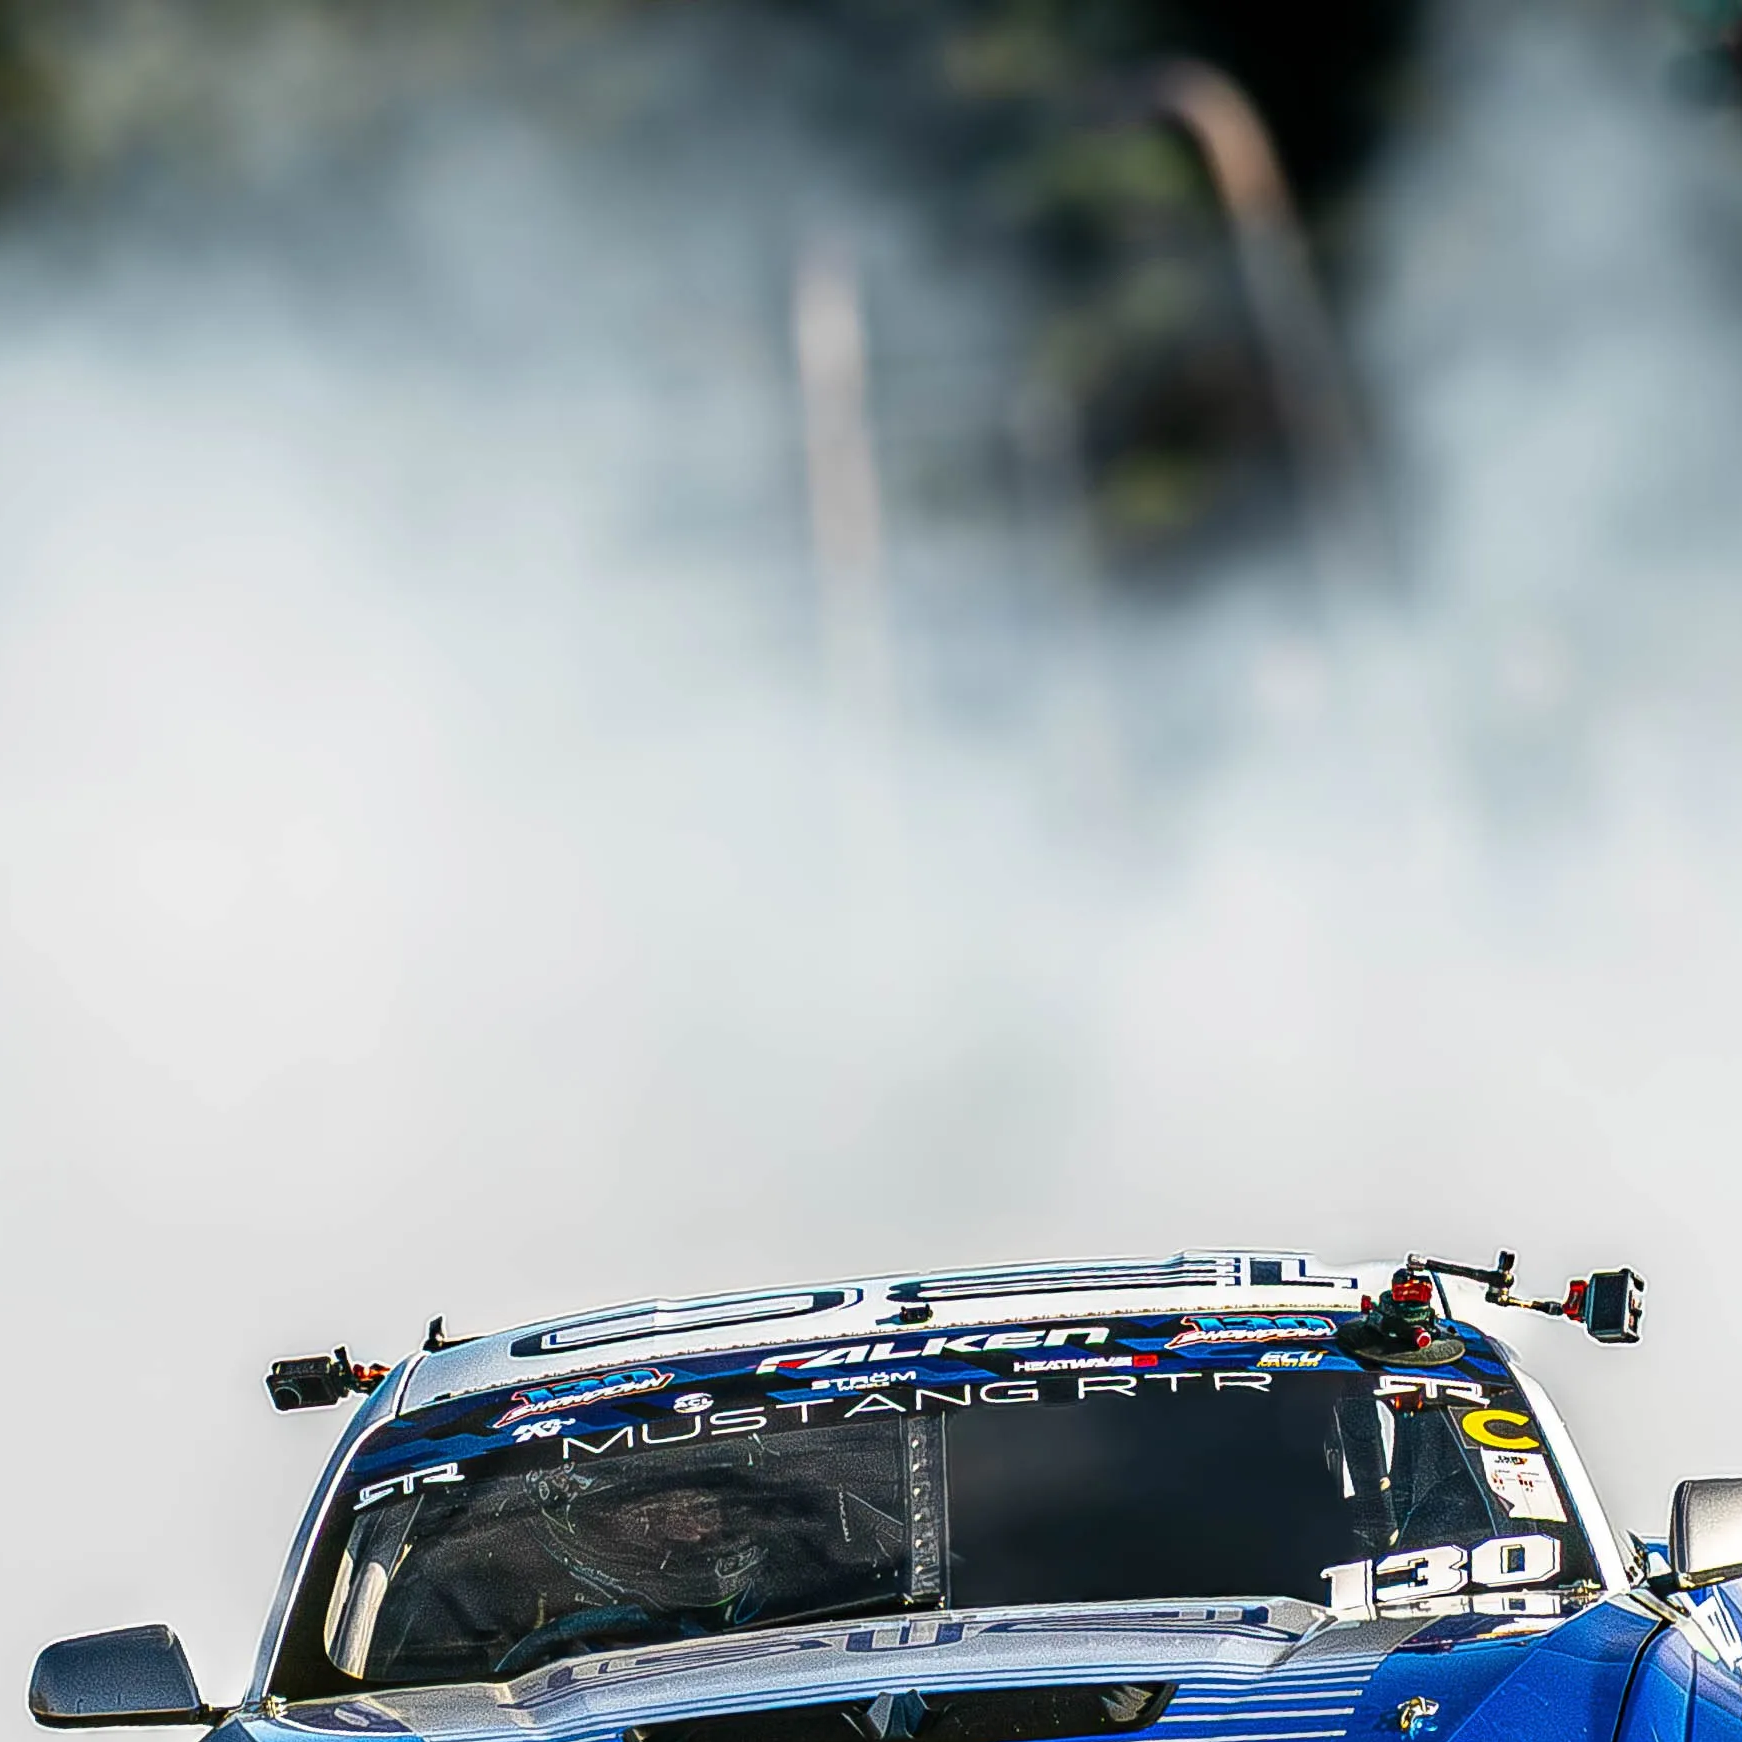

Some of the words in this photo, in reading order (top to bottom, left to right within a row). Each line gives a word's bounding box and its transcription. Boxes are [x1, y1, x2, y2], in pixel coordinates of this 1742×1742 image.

[756, 1327, 1109, 1374] FALKEN
[562, 1379, 1039, 1460] MUSTANG
[1078, 1372, 1273, 1400] RTR
[1462, 1409, 1540, 1449] C
[1320, 1534, 1561, 1622] 130
